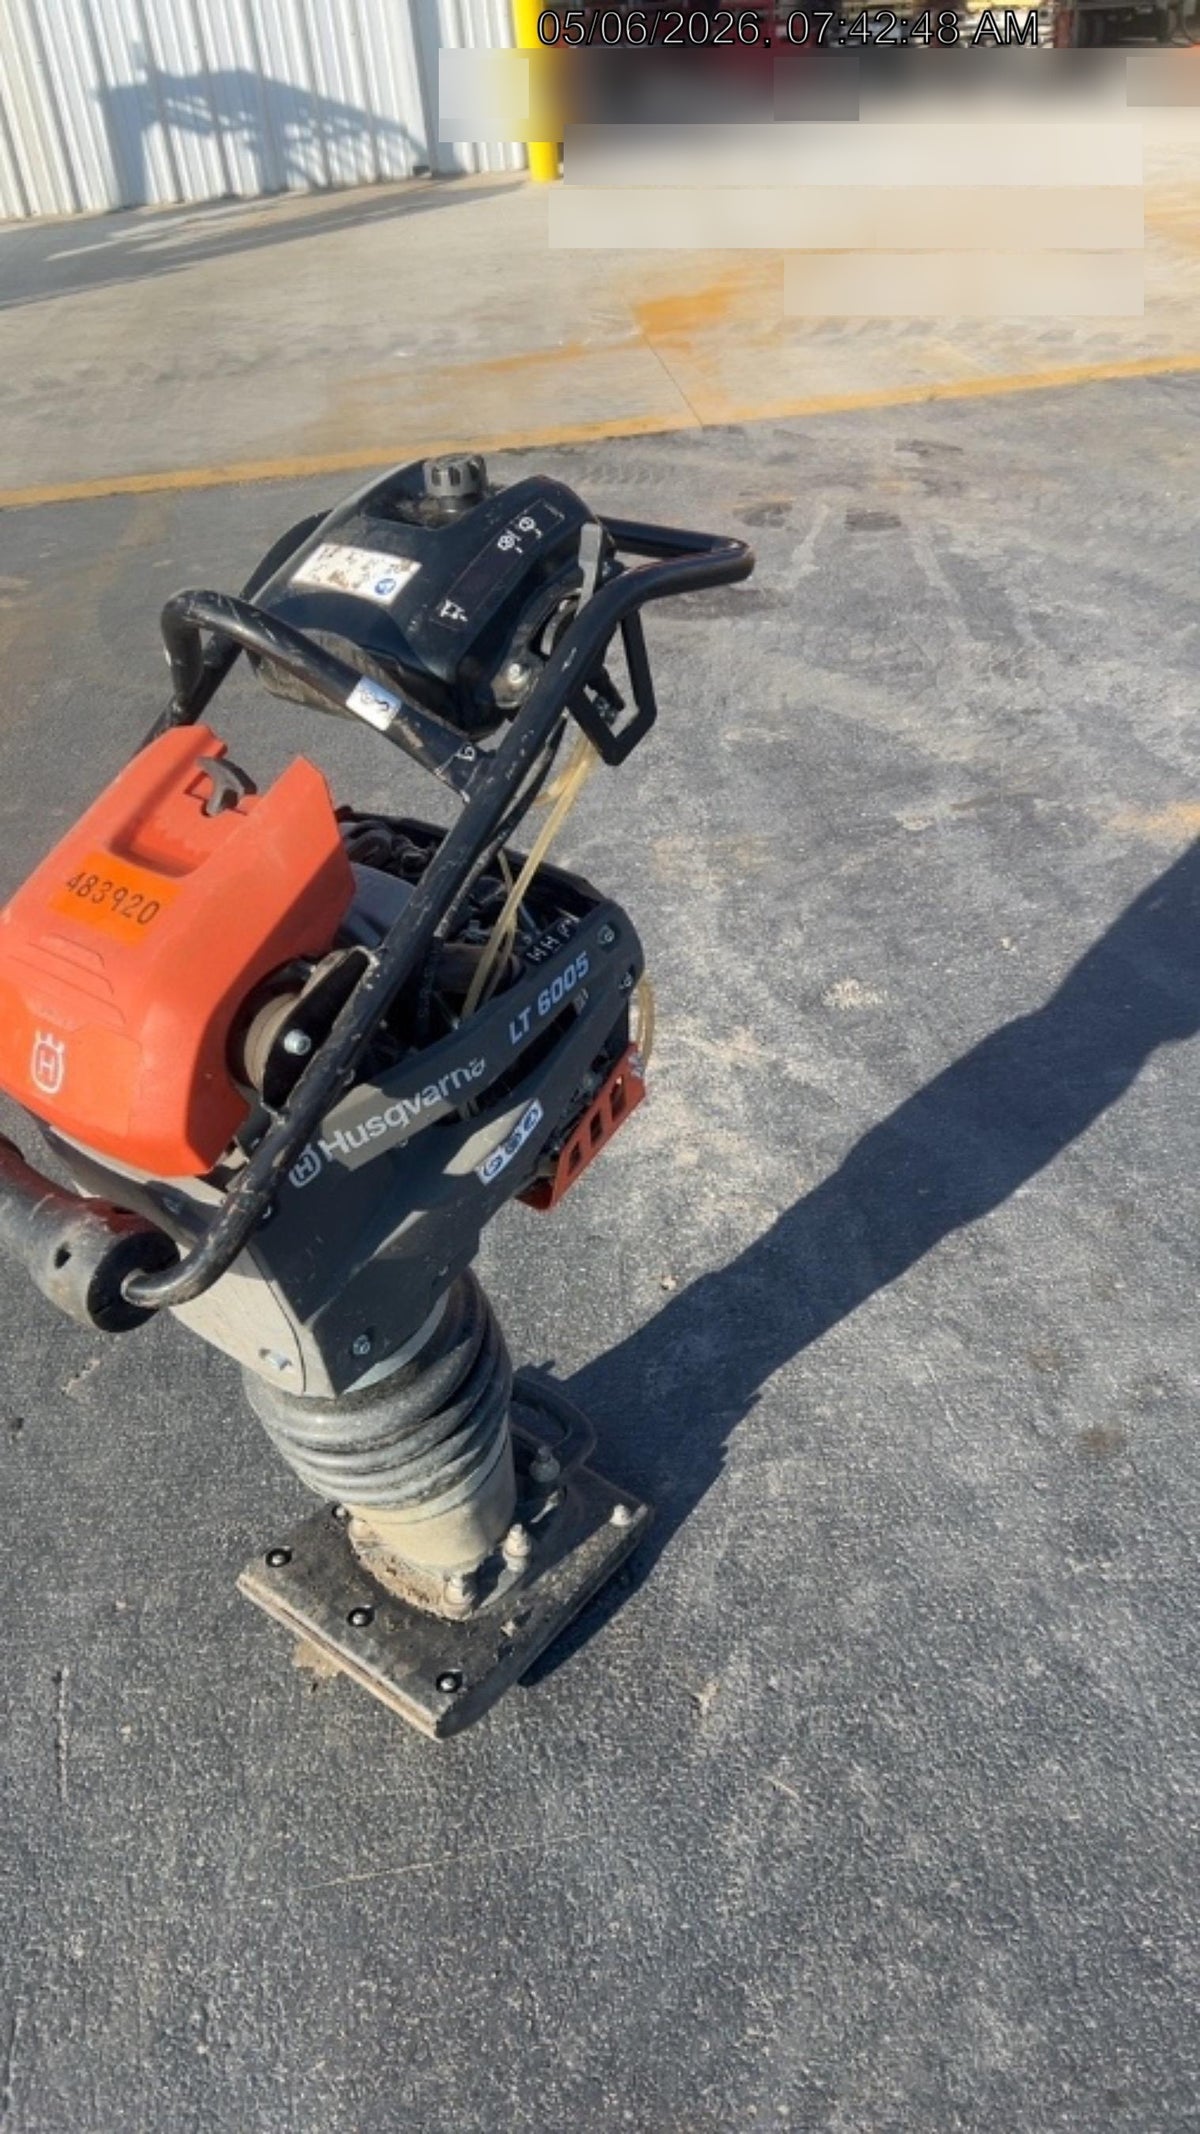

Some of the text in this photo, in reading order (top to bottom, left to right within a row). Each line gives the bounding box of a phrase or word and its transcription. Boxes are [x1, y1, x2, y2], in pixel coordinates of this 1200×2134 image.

[65, 871, 160, 926] 483920
[509, 950, 589, 1045] LT 6005
[317, 1056, 486, 1162] Husqvarna
